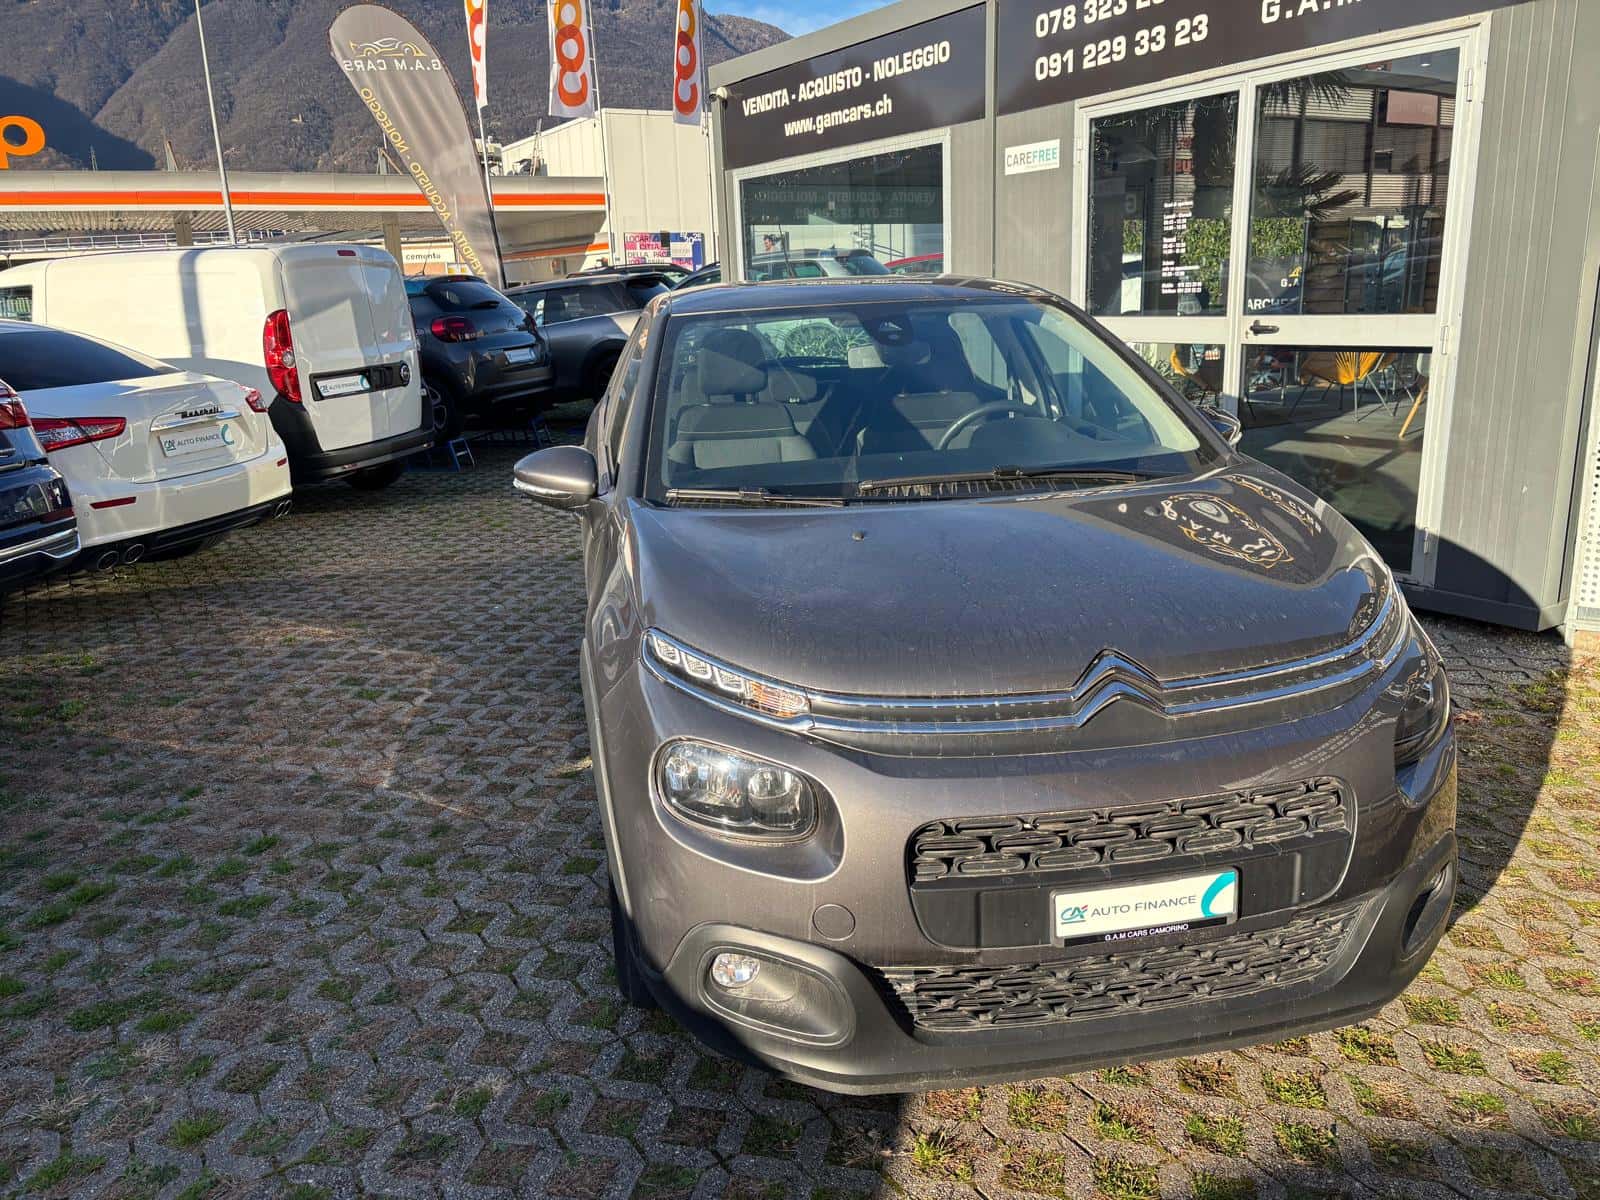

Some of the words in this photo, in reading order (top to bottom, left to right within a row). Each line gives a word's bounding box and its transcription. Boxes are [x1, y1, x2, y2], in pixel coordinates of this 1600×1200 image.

[1035, 4, 1077, 38] 078
[1083, 0, 1128, 24] 323
[1035, 49, 1074, 81] 091
[1082, 35, 1127, 69] 229
[1134, 24, 1166, 56] 33
[1174, 13, 1209, 47] 23
[742, 88, 790, 117] VENDITA
[798, 66, 863, 102] ACQUISTO
[873, 40, 950, 82] NOLEGGIO
[784, 93, 892, 137] www.gamcars.ch
[1007, 147, 1057, 167] CAREFREE
[1091, 904, 1130, 917] AUTO
[1135, 895, 1198, 912] FINANCE
[1127, 929, 1148, 938] CARS
[1149, 923, 1189, 935] CAMORINO
